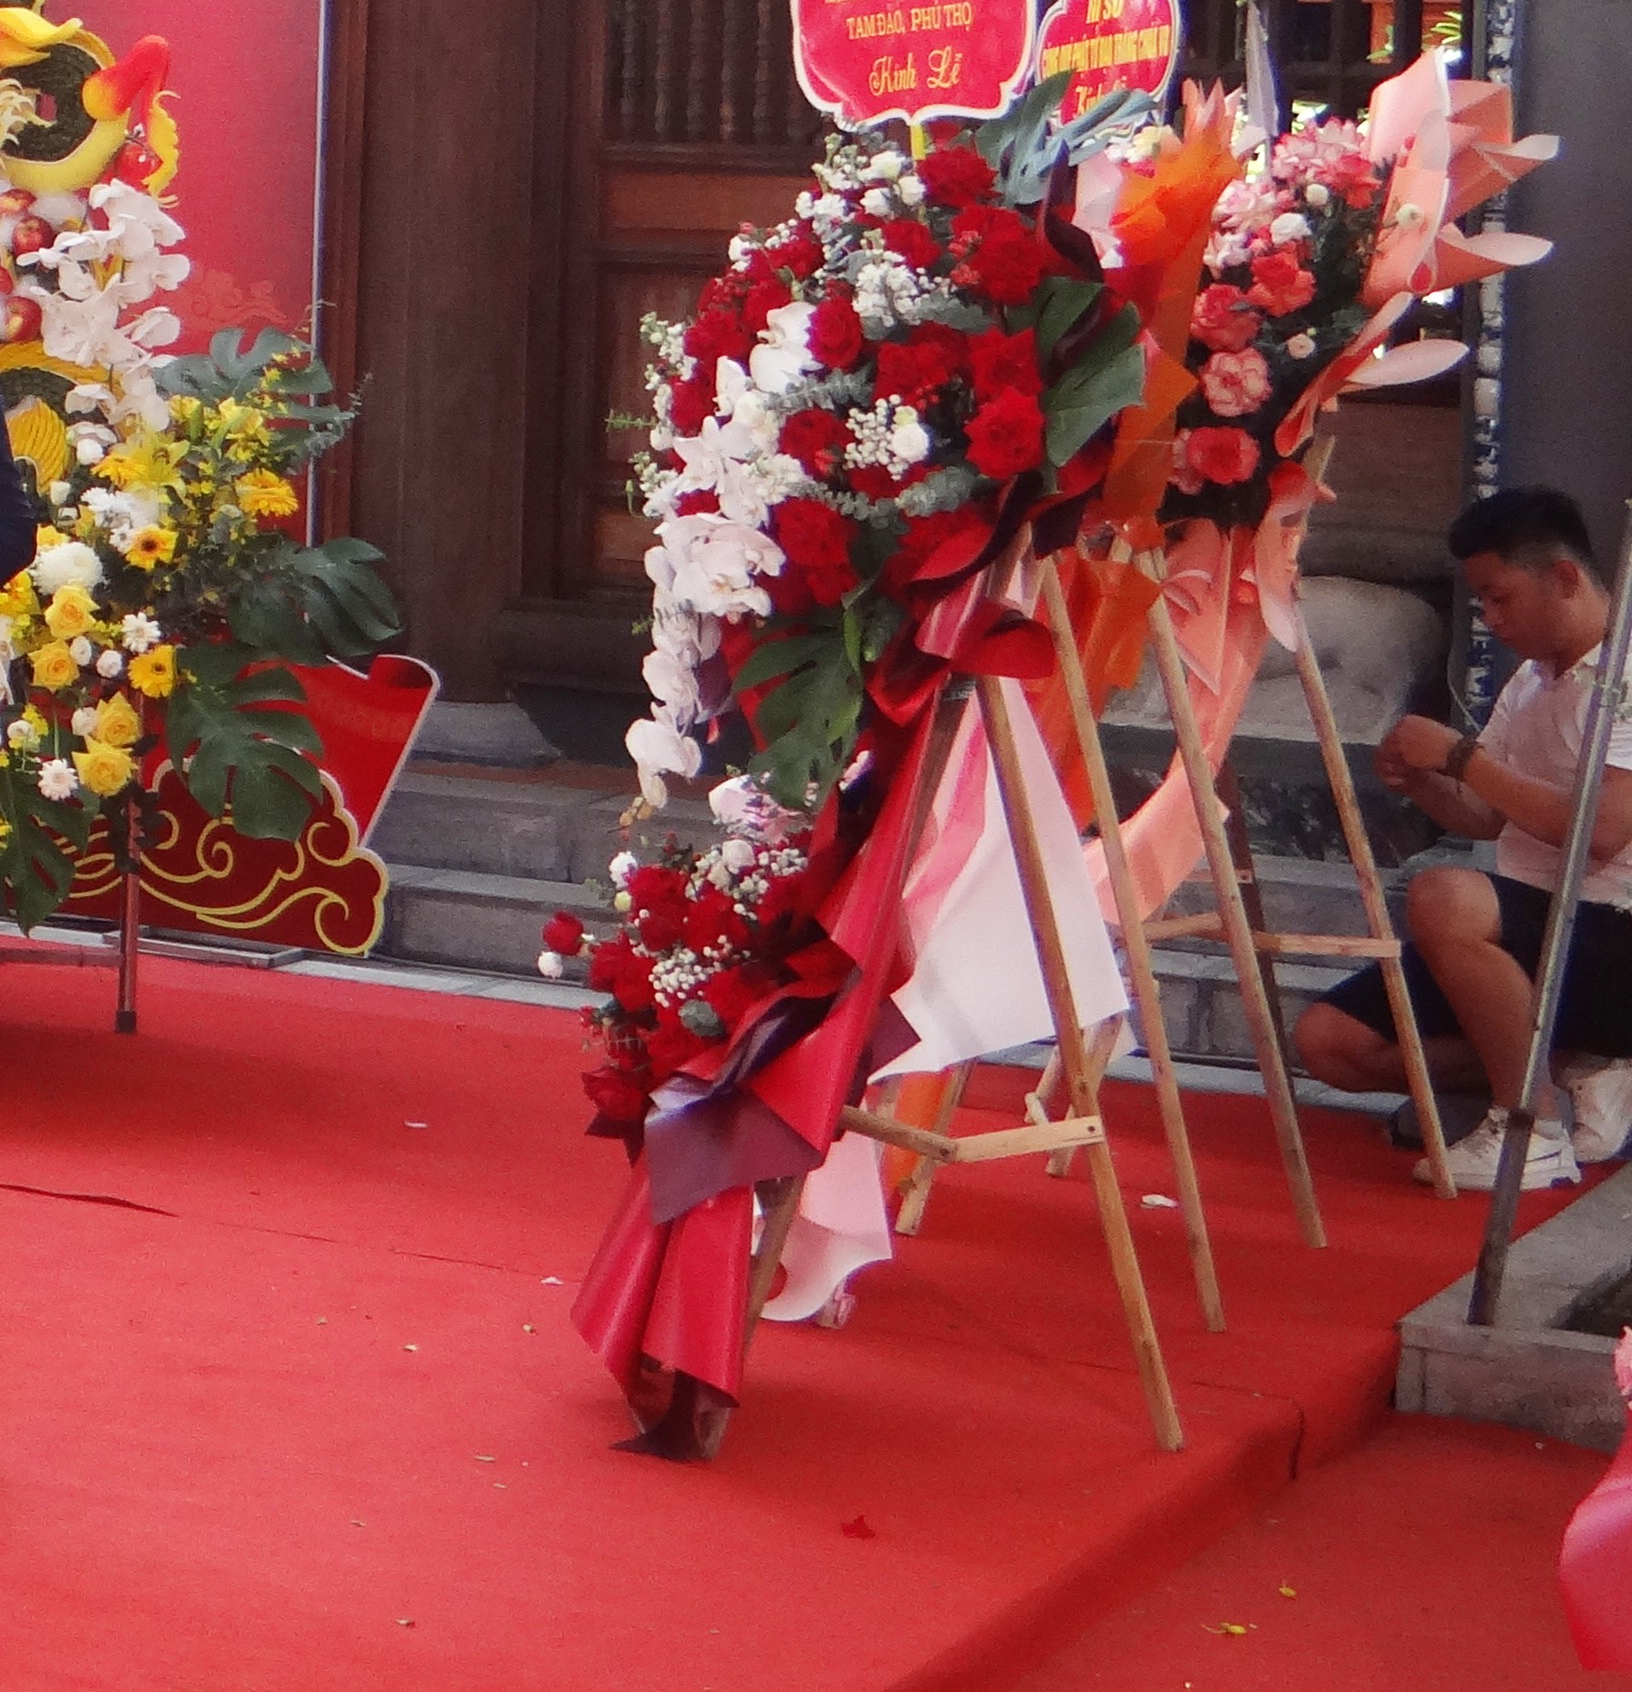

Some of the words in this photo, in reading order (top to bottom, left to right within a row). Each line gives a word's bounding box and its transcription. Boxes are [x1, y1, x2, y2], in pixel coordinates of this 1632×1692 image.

[846, 12, 876, 40] TAM
[943, 2, 972, 31] THỌ
[869, 53, 916, 96] Kính
[927, 46, 963, 88] Lễ
